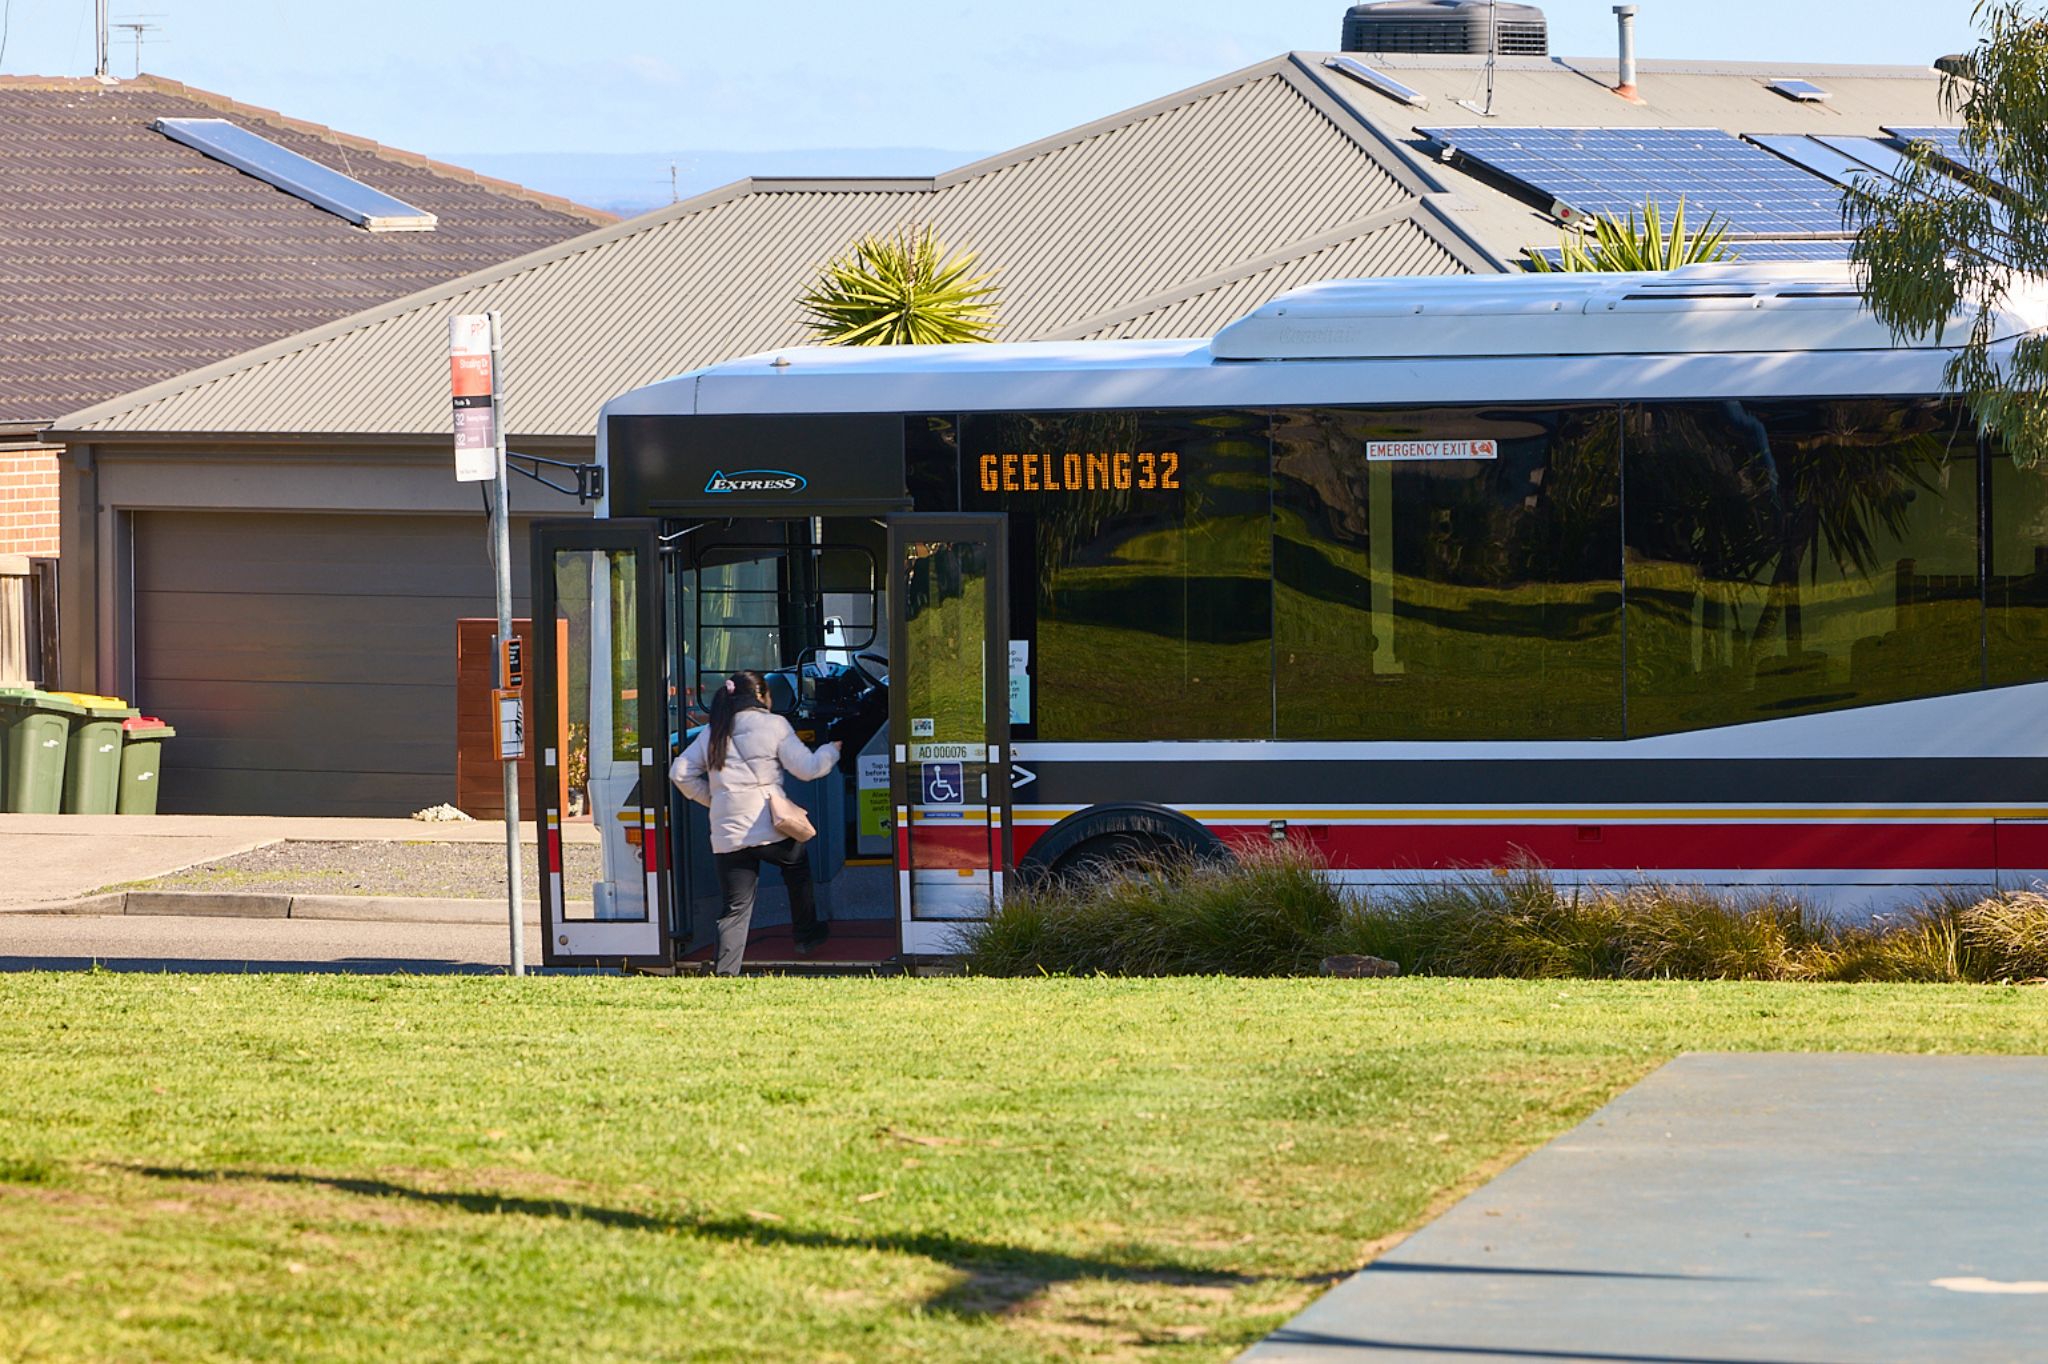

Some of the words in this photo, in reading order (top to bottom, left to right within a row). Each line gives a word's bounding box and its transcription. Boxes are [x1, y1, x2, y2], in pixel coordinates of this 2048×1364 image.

[455, 413, 465, 426] 32
[456, 433, 467, 446] 32
[1369, 443, 1439, 457] EMERGENCY
[1442, 442, 1468, 456] EXIT
[865, 768, 882, 776] before
